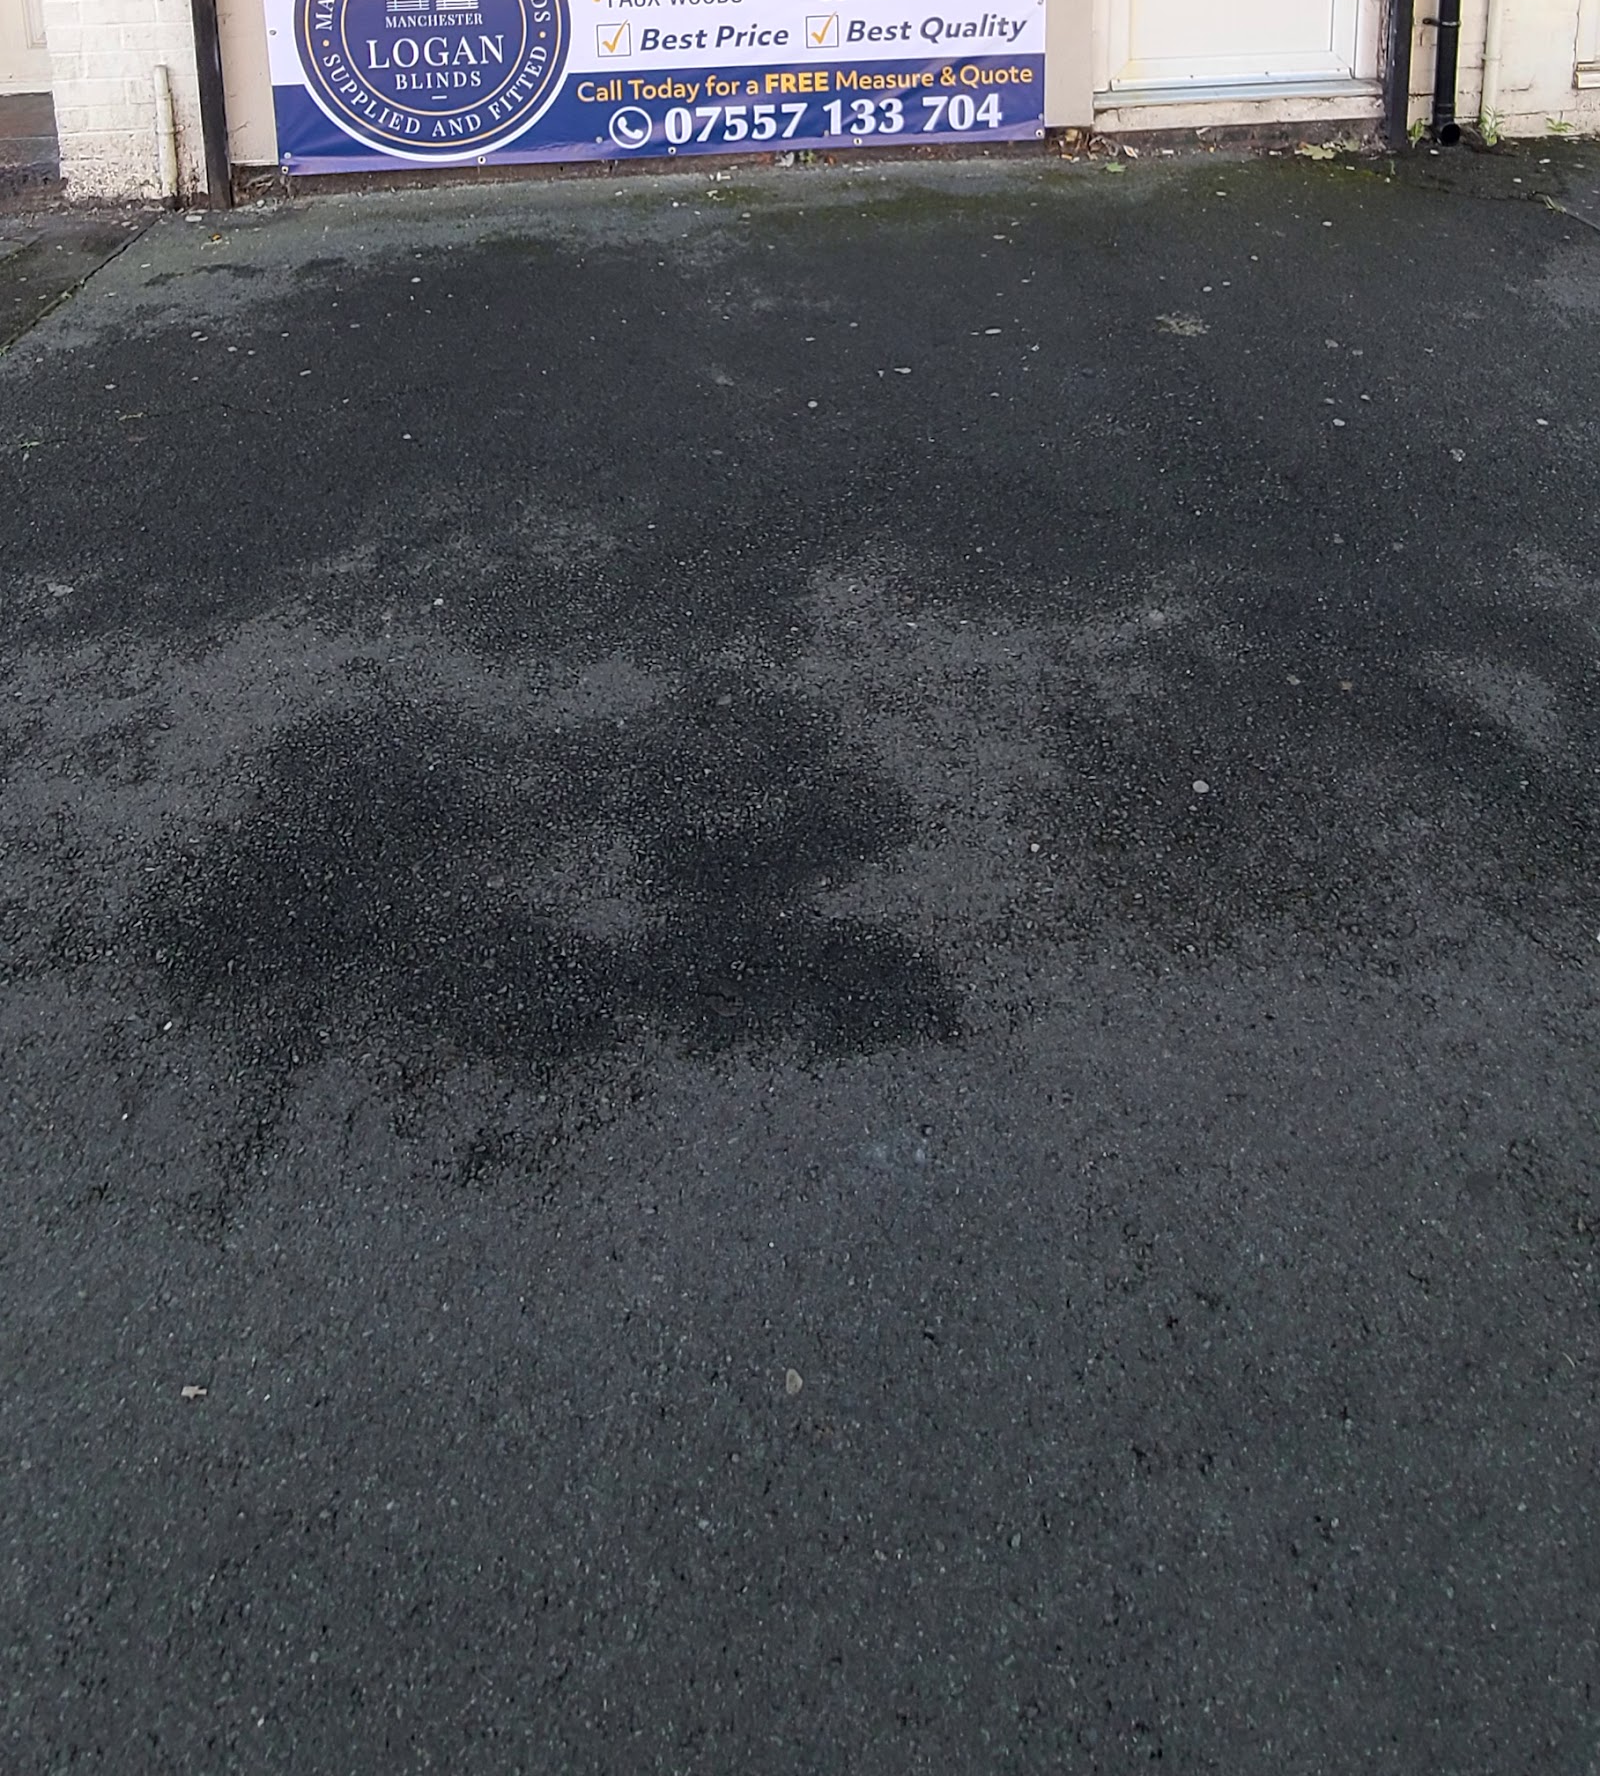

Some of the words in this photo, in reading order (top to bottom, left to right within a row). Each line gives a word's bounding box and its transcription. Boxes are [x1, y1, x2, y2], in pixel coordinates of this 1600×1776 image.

[385, 12, 483, 28] MANCHESTER
[846, 19, 912, 43] Best
[920, 13, 1027, 42] Quality
[366, 35, 504, 69] LOGAN
[639, 27, 707, 51] Best
[715, 23, 789, 49] Price
[323, 54, 420, 135] SUPPLIED
[432, 113, 481, 137] AND
[488, 45, 547, 120] FITTED
[395, 70, 482, 90] BLINDS
[577, 79, 622, 102] Call
[628, 79, 700, 104] Today
[704, 75, 741, 96] for
[746, 79, 758, 95] a
[765, 71, 828, 94] FREE
[835, 69, 934, 90] Measure
[940, 66, 956, 86] &
[959, 63, 1033, 87] Quote
[664, 102, 808, 144] 07557
[824, 98, 904, 137] 133
[922, 93, 1002, 132] 704
